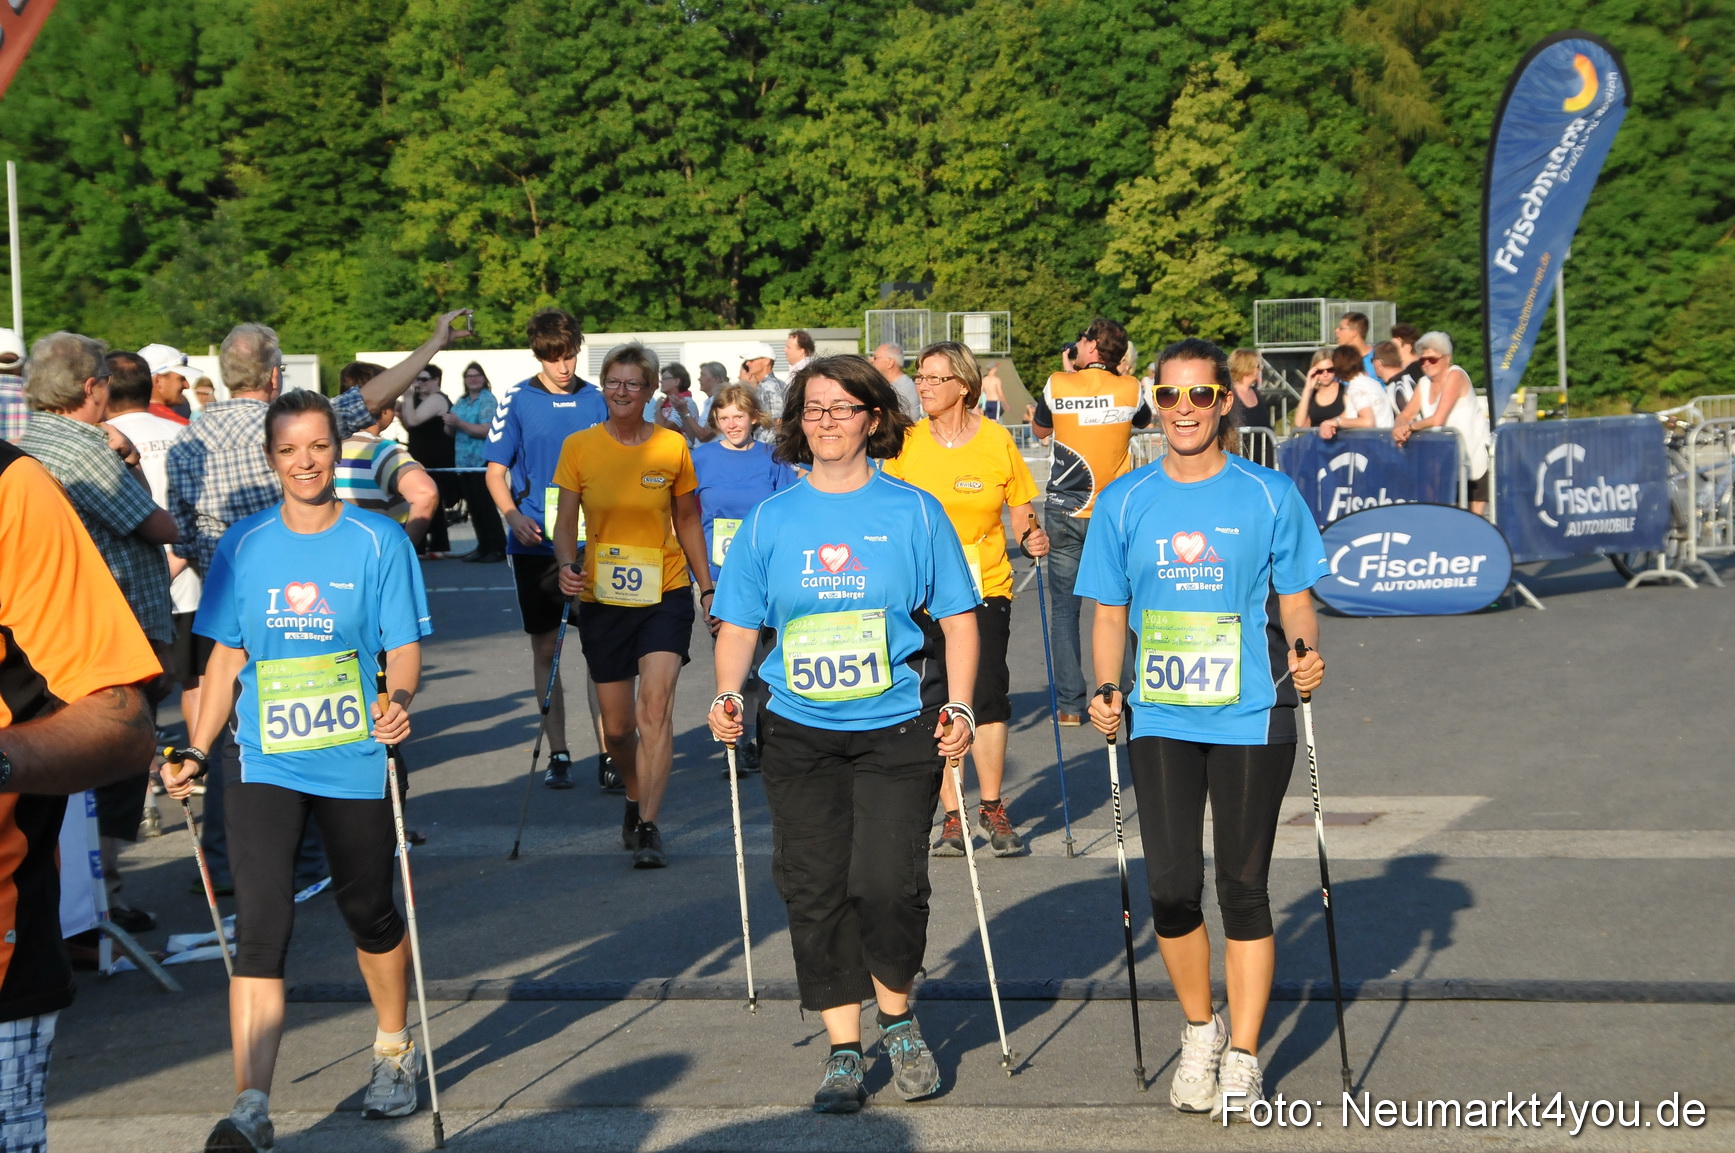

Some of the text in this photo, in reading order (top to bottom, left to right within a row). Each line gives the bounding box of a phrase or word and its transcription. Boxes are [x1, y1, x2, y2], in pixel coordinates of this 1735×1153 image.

[1560, 144, 1586, 184] Druck
[1494, 117, 1588, 274] Frischmann
[1500, 252, 1552, 370] www.frischmann-net.de
[1055, 396, 1109, 410] Benzin
[1084, 409, 1135, 424] im Blut
[1554, 476, 1640, 516] Fischer
[1564, 517, 1637, 537] AUTOMOBILE
[801, 549, 815, 575] I
[1155, 538, 1170, 566] I
[1157, 562, 1224, 582] camping
[1359, 551, 1487, 580] Fischer
[611, 566, 643, 592] 59
[801, 572, 866, 591] camping
[1199, 582, 1224, 592] Berger
[1371, 576, 1478, 593] AUTOMOBILE
[266, 588, 281, 614] I
[841, 590, 865, 600] Berger
[266, 614, 334, 633] camping
[789, 619, 815, 631] 2014
[1145, 614, 1169, 624] 2014
[308, 632, 334, 642] Berger
[260, 664, 287, 675] 2014
[792, 652, 880, 690] 5051
[1145, 654, 1234, 692] 5047
[266, 694, 361, 739] 5046
[1307, 744, 1322, 821] NORDIC
[1112, 782, 1125, 850] NORDIC
